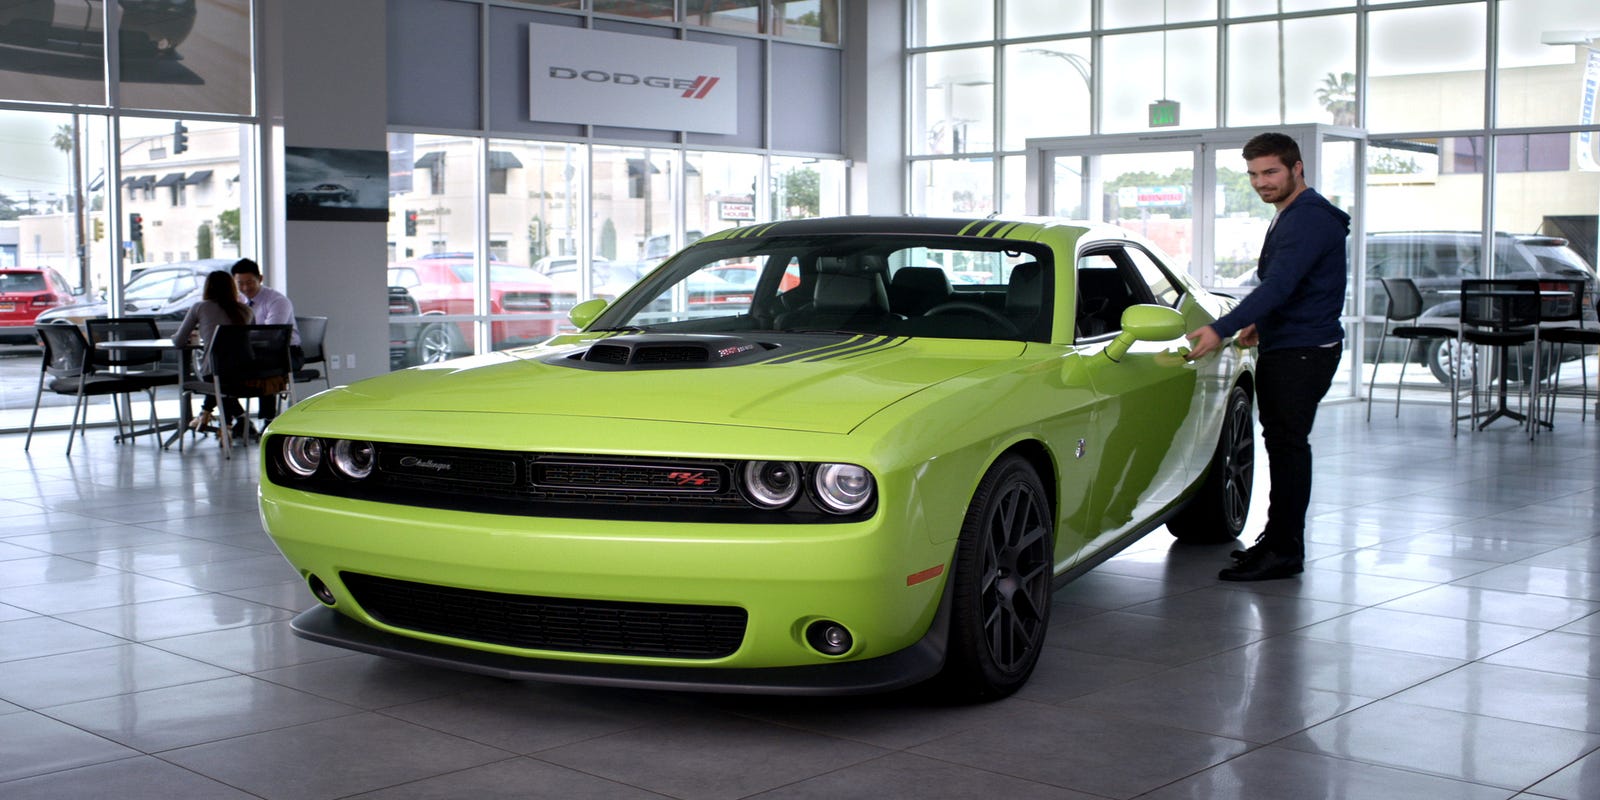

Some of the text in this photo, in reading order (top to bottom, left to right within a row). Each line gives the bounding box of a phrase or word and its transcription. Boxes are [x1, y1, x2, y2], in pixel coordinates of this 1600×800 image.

[548, 66, 698, 91] DODGE
[400, 456, 452, 472] Challenger
[667, 471, 711, 486] R/T
